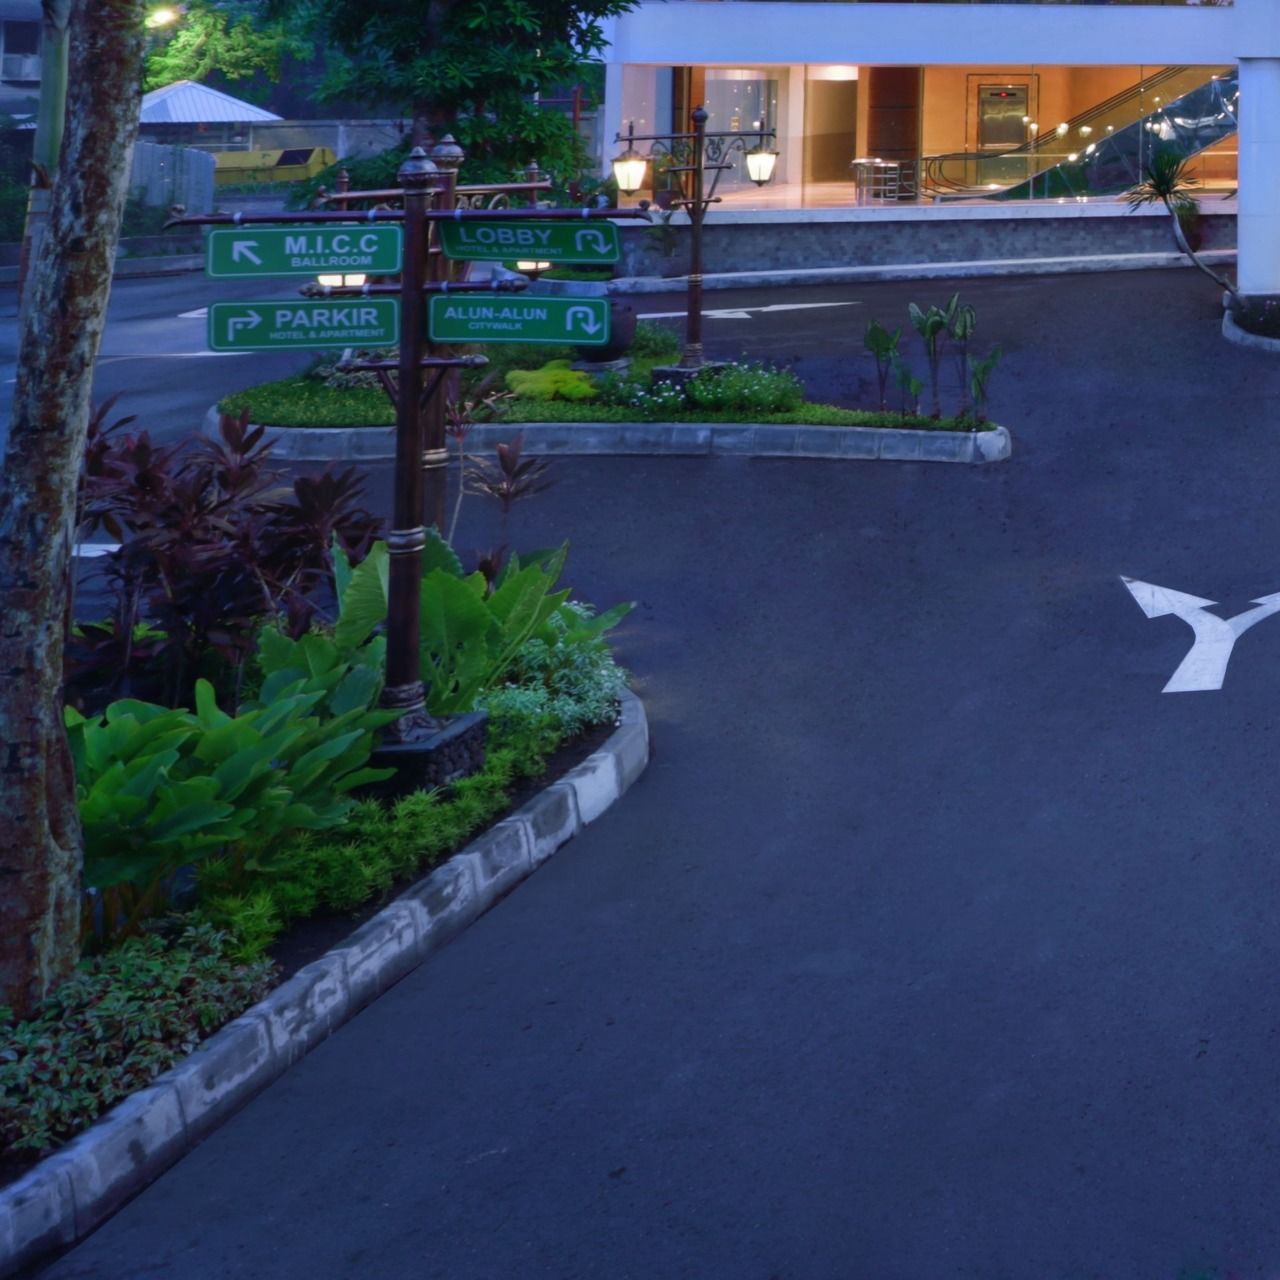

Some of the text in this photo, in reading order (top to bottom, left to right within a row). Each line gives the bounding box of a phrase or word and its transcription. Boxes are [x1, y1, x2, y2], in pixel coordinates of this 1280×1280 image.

[459, 227, 552, 245] LOBBY
[284, 234, 379, 255] M.I.C.C
[291, 255, 372, 268] BALLROOM
[275, 307, 379, 328] PARKIR
[444, 306, 548, 320] ALUN-ALUN
[468, 321, 523, 331] CITYWALK
[269, 330, 306, 340] HOTEL
[320, 328, 385, 338] APARTMENT
